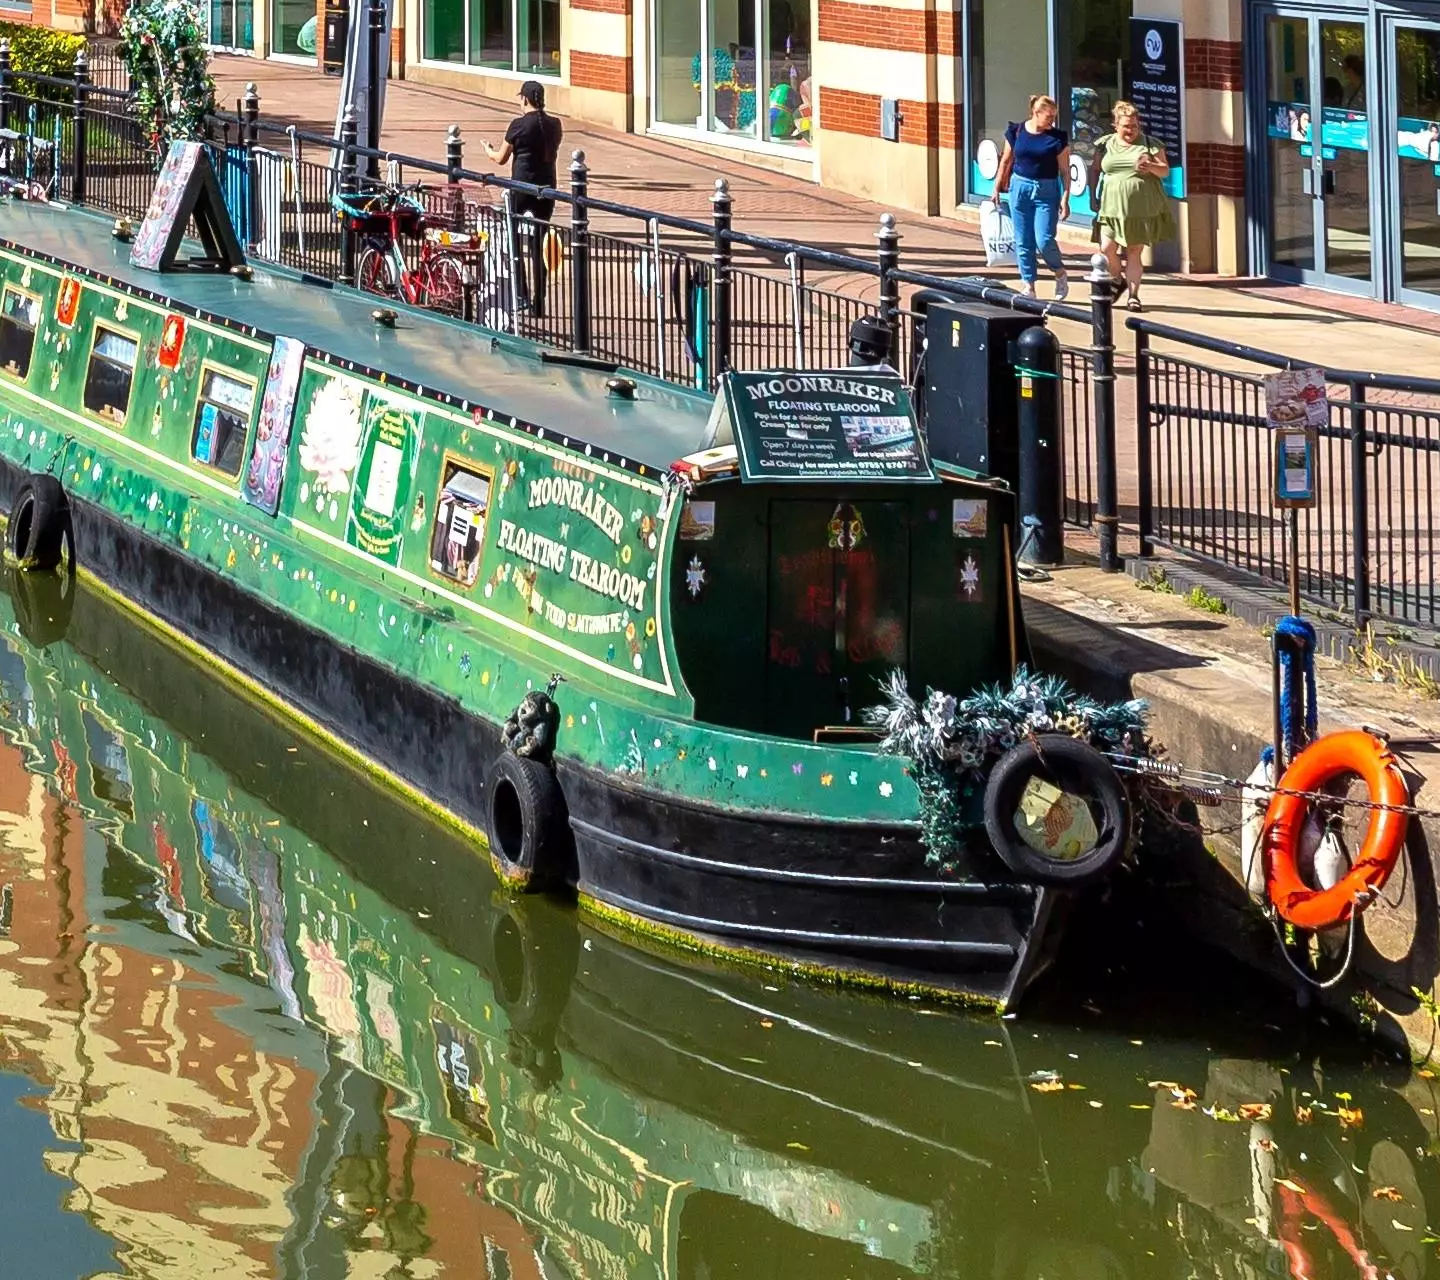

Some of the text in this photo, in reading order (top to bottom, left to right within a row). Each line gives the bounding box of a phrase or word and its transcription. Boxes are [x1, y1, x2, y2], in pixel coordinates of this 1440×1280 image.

[1133, 81, 1176, 93] OPENING HOURS
[746, 377, 896, 405] MOONRAKER
[768, 400, 880, 414] FLOATING TEAROOM
[528, 477, 623, 545] MOONRAKER
[497, 519, 567, 573] FLOATING
[570, 550, 647, 611] TEAROOM
